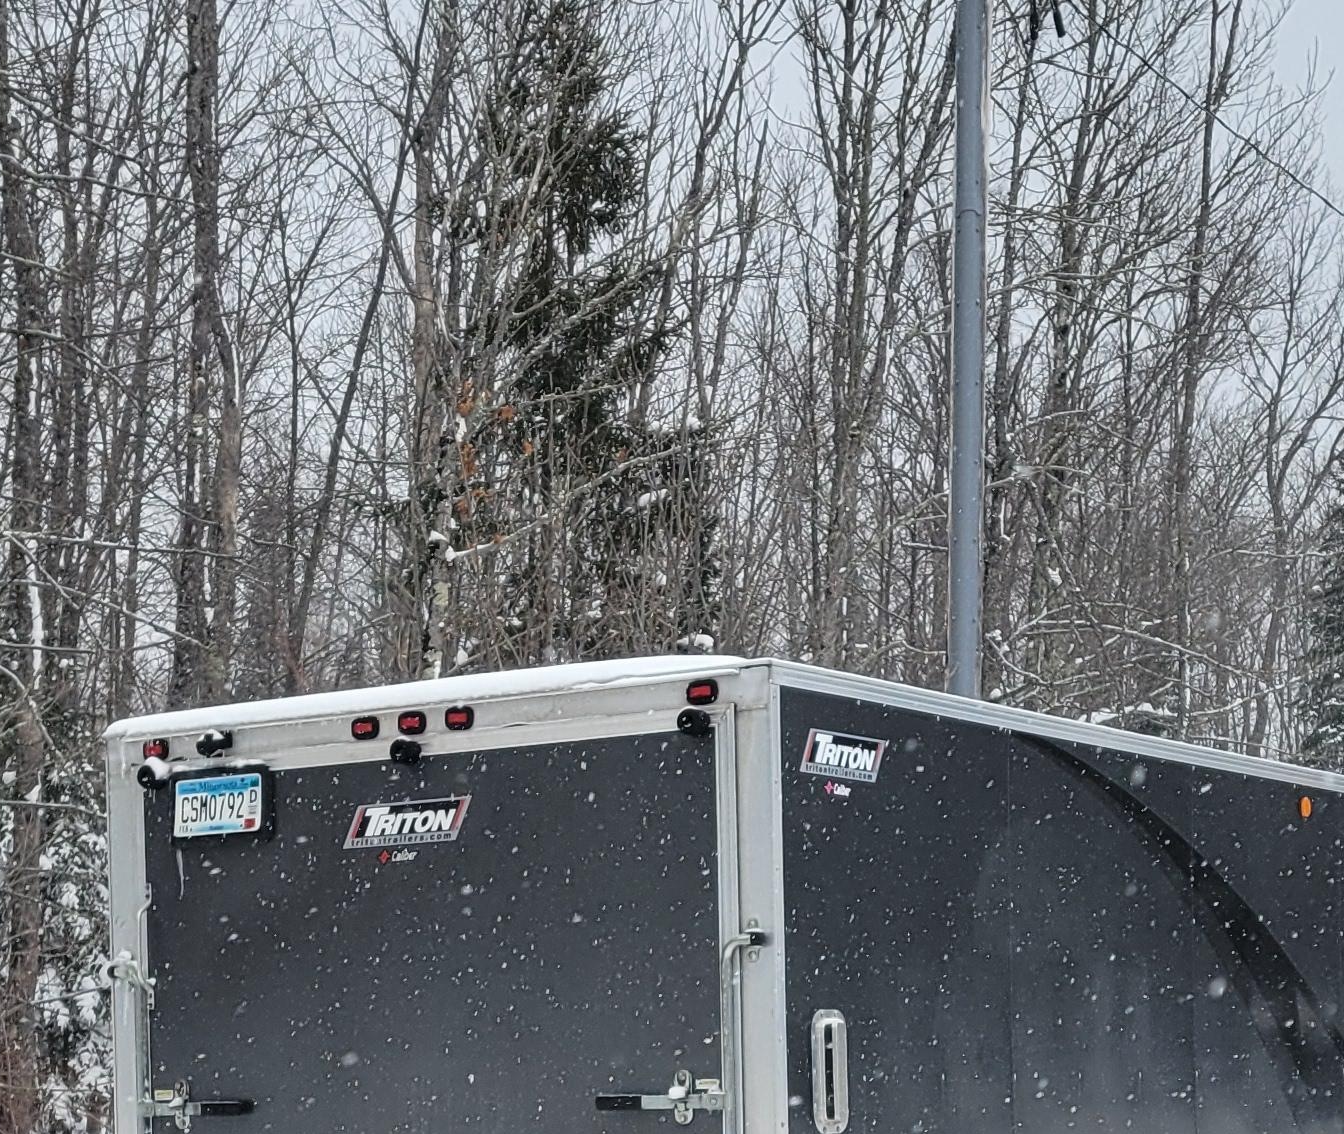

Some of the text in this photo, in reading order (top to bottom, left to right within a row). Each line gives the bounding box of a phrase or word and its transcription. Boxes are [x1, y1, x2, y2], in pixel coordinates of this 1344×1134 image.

[815, 732, 876, 771] TRITON
[181, 791, 244, 824] CSM0792
[250, 789, 258, 804] D
[364, 806, 456, 836] TRITON
